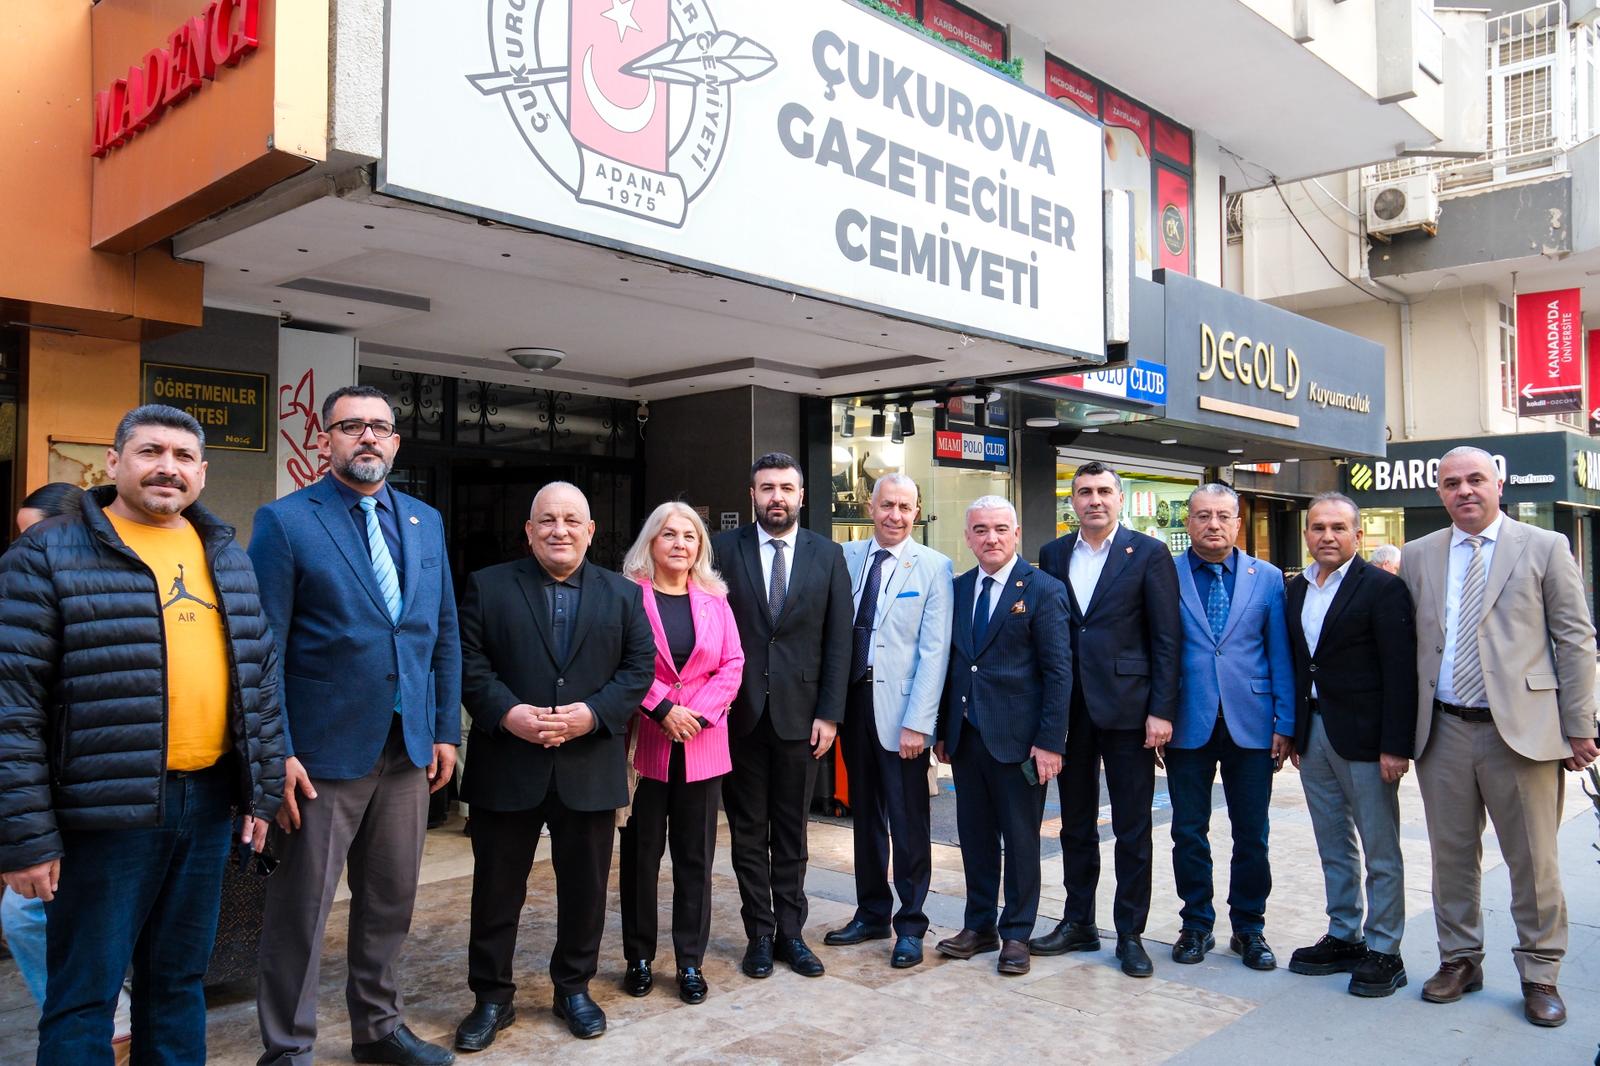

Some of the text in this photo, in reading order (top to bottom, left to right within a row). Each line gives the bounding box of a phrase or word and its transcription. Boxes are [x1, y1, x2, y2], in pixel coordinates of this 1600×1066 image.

[934, 15, 993, 53] KARBON PEELING
[812, 30, 1056, 176] ÇUKUROVA
[1050, 75, 1094, 104] MICROBLADING
[596, 162, 666, 196] ADANA
[777, 102, 1076, 251] GAZETECİLER
[607, 186, 656, 212] 1975
[835, 208, 1038, 309] CEMİYETİ
[1547, 300, 1560, 379] KANADA'DA
[1560, 312, 1573, 364] ÜNİVERSİTE
[1087, 366, 1165, 395] OLO CLUB
[1198, 323, 1371, 414] DEGOLD Kuyumculuk
[154, 376, 256, 406] ÖĞRETMENLER
[938, 437, 1005, 456] MIAMI POLO CLUB
[1374, 455, 1507, 491] BARGO
[178, 612, 196, 622] AIR
